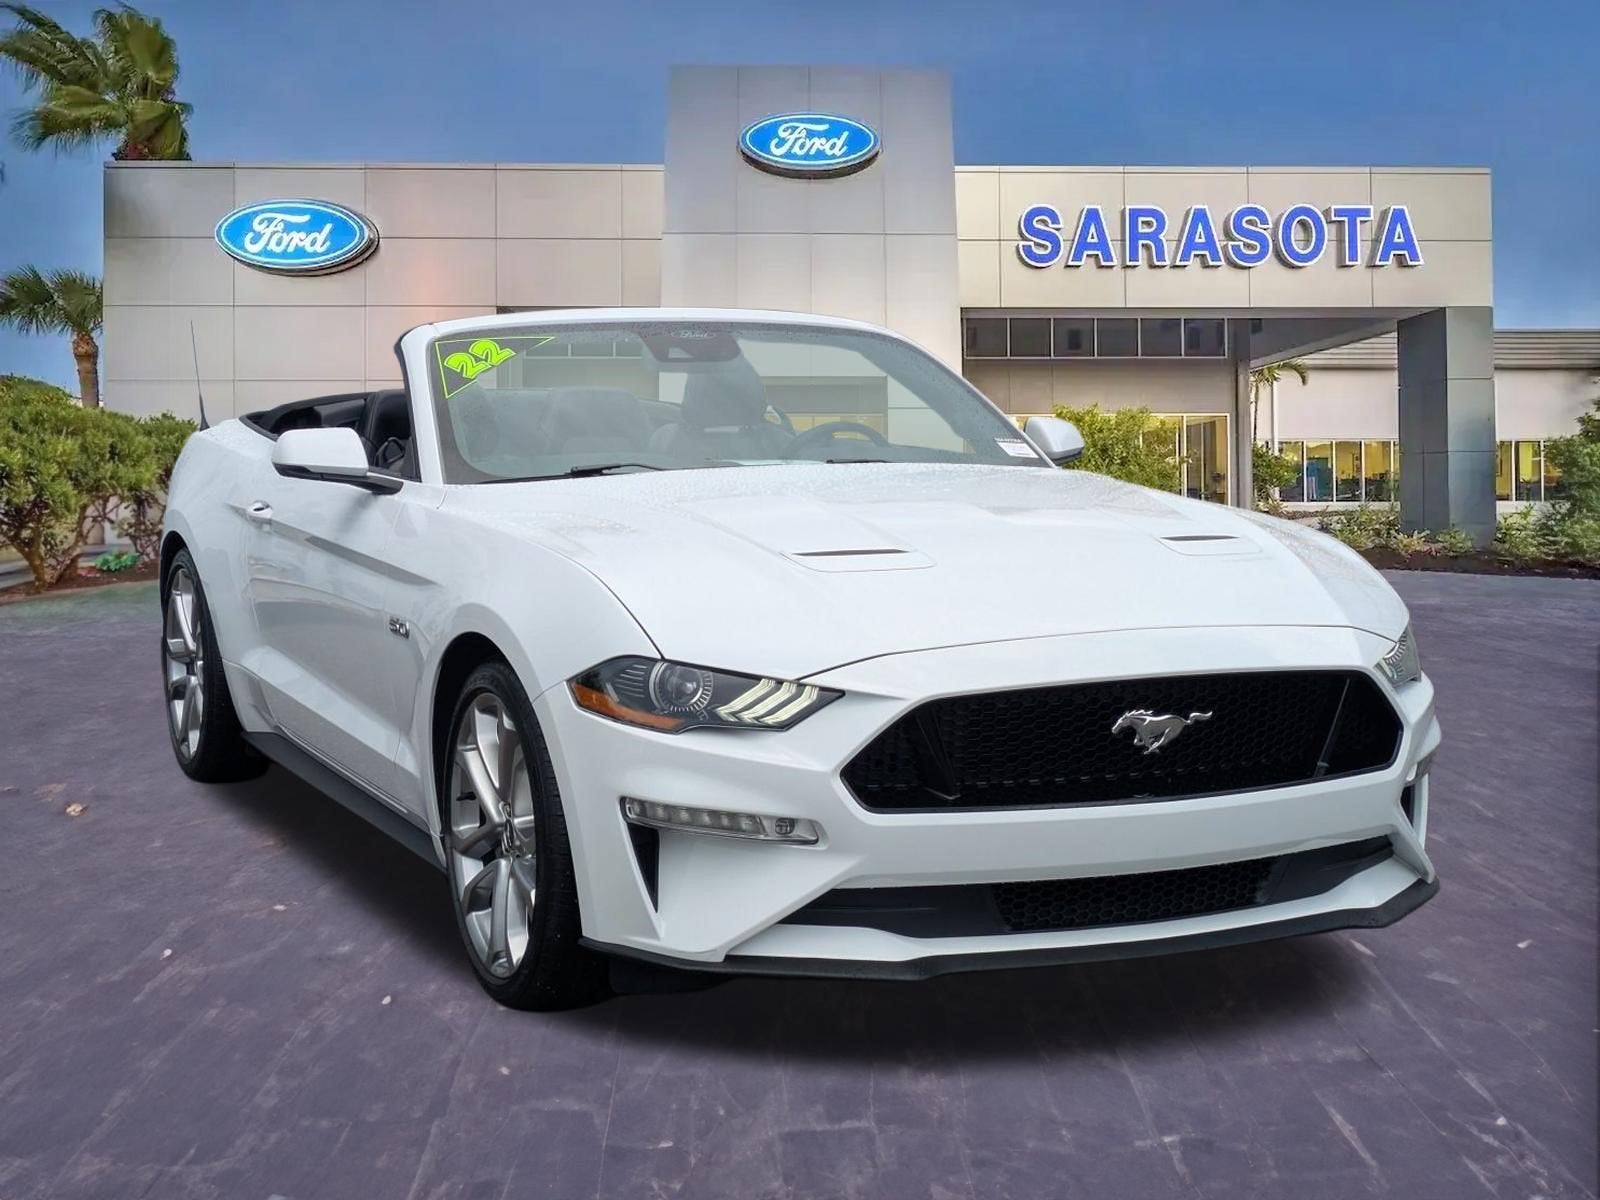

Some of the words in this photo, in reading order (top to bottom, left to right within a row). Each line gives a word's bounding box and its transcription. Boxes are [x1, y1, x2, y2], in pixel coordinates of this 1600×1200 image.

[770, 122, 849, 156] Ford
[244, 212, 333, 253] Ford
[1017, 204, 1424, 268] SARASOTA
[443, 338, 516, 379] 22
